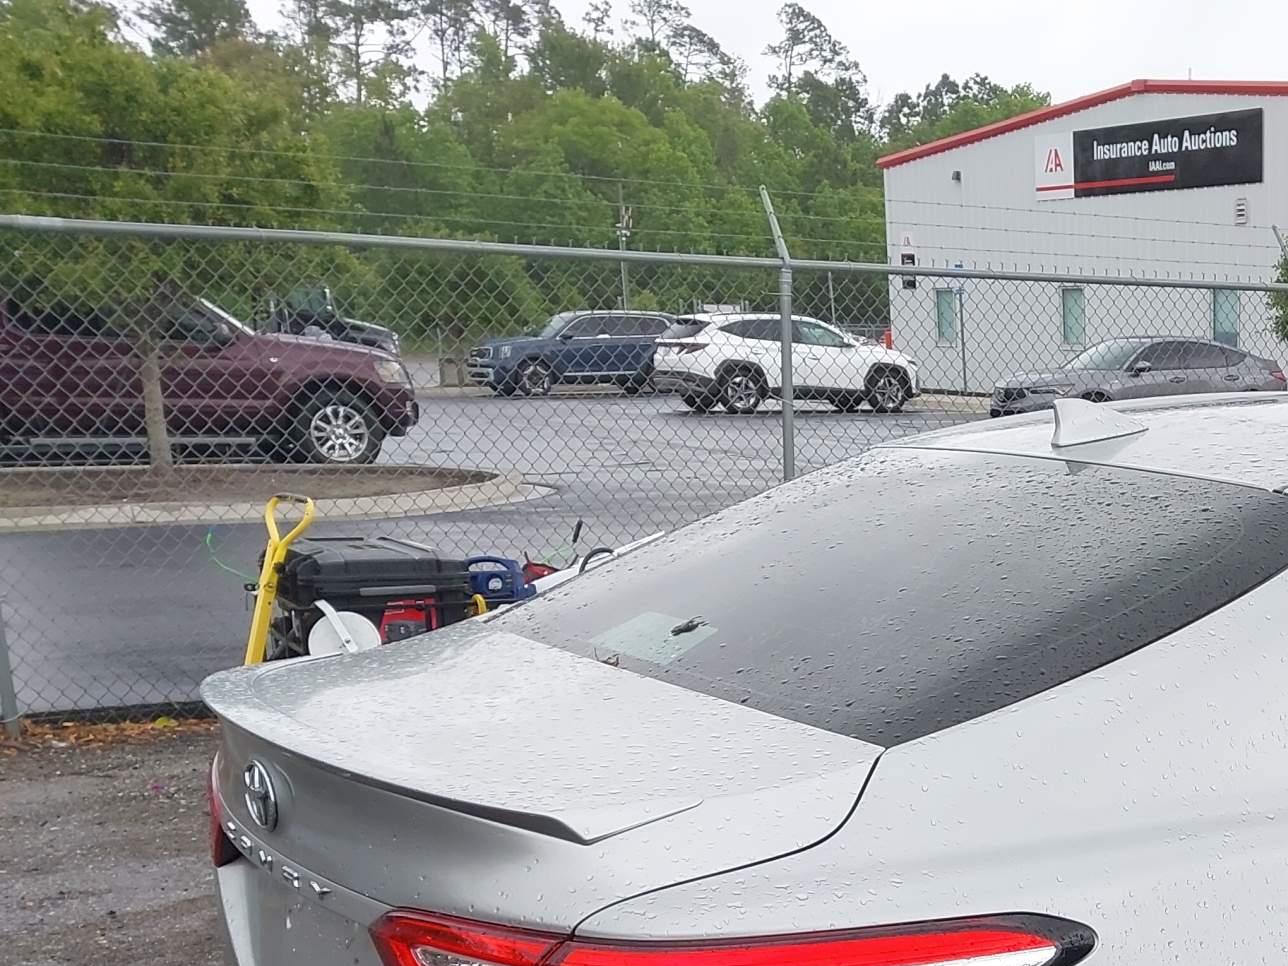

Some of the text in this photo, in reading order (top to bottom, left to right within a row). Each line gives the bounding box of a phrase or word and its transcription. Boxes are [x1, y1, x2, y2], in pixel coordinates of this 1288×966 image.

[1093, 126, 1238, 160] Insurance Auto Auctions
